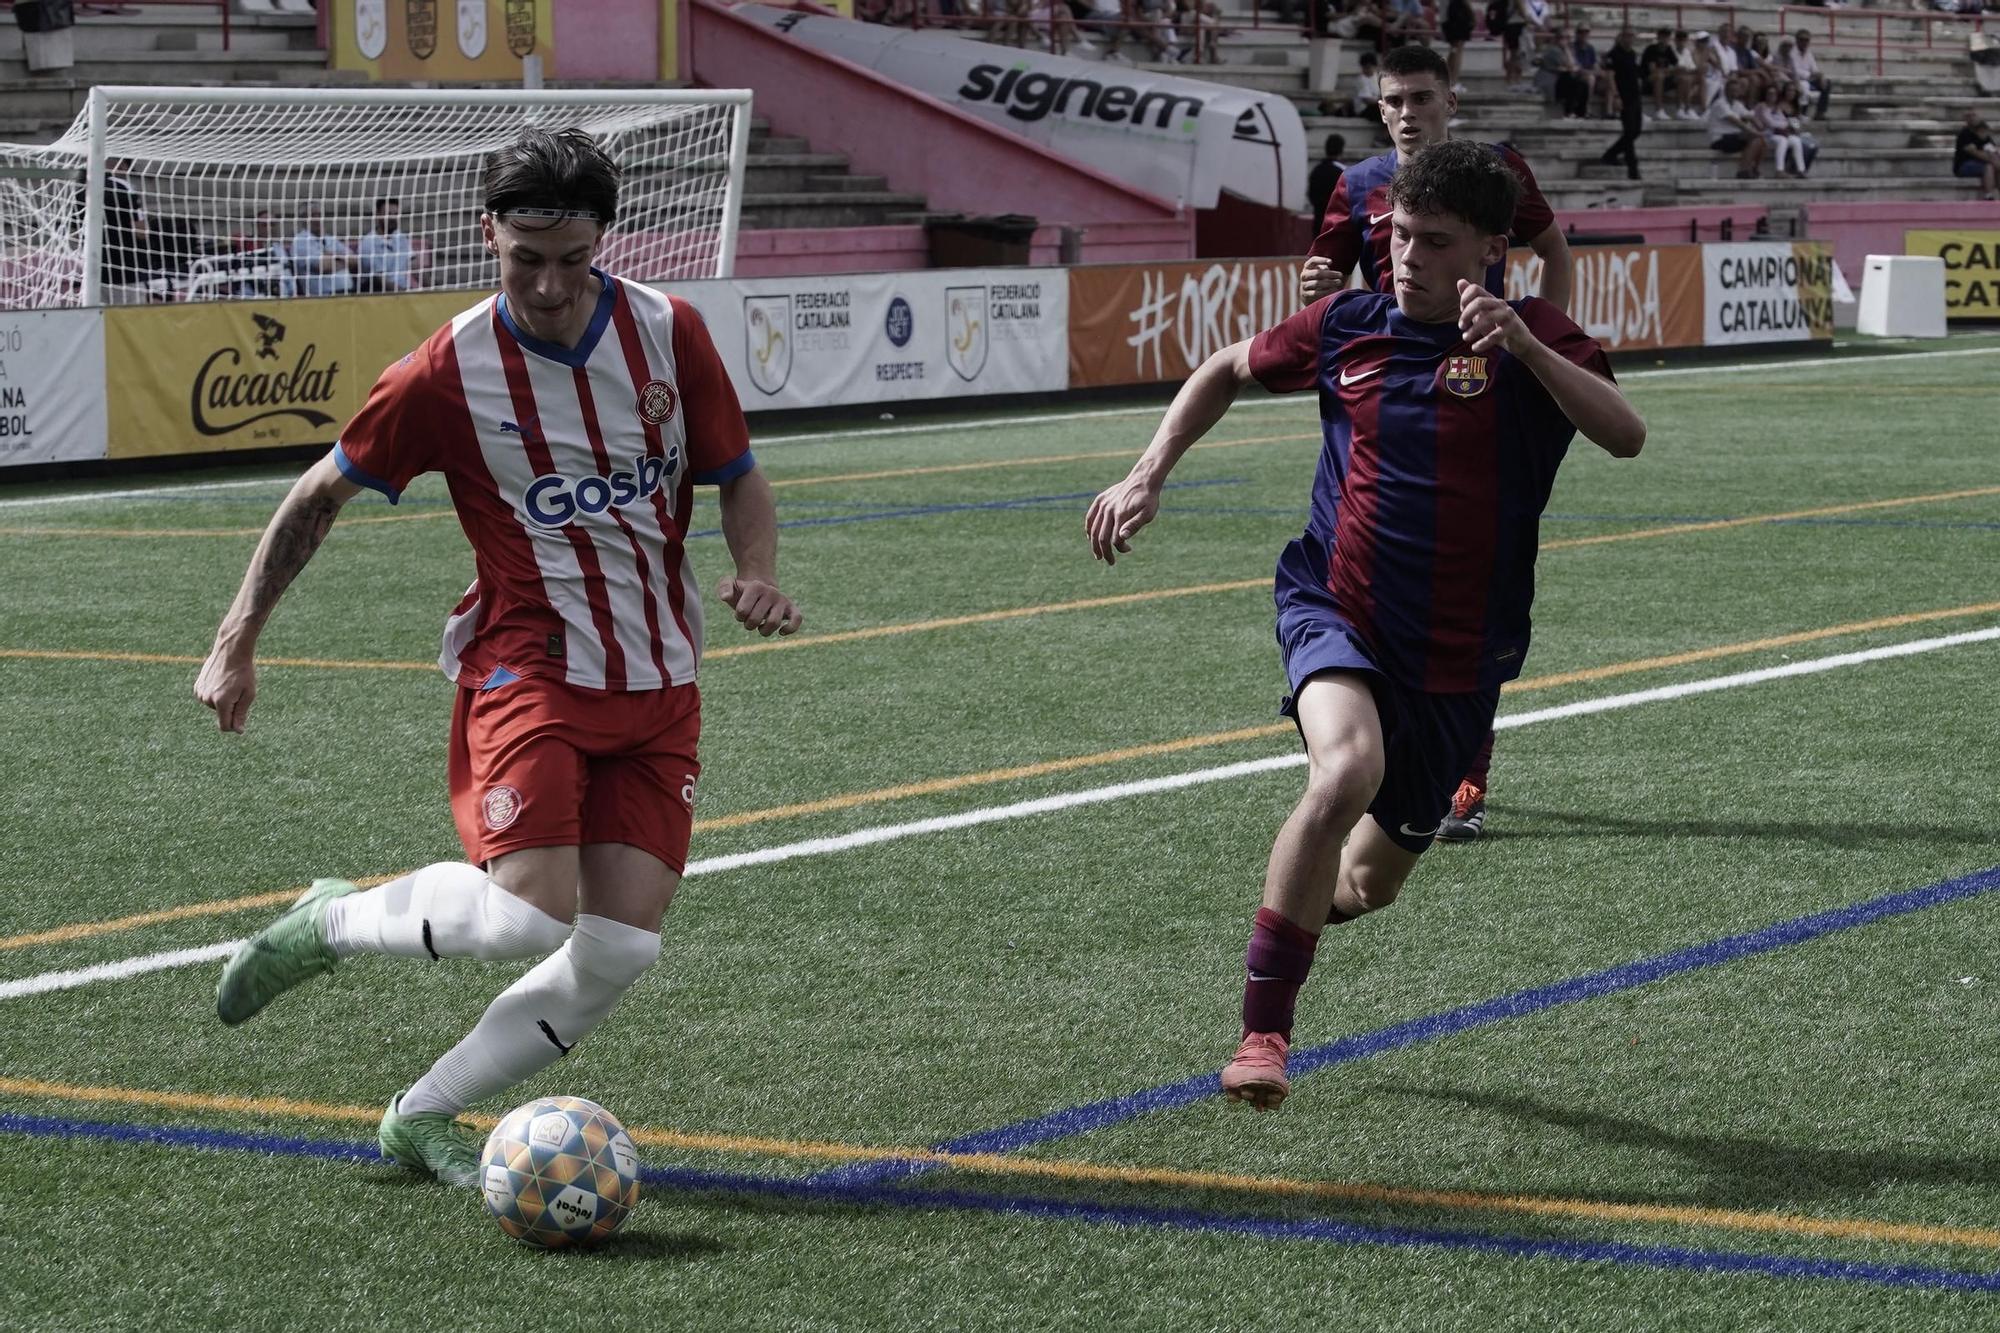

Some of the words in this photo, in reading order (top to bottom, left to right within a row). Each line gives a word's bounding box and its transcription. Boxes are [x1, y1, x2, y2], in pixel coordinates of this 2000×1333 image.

[958, 60, 1204, 134] signem
[1720, 256, 1833, 289] CAMPIONAT
[795, 291, 850, 310] FEDERACIÓ
[990, 282, 1041, 300] FEDERACIÓ
[795, 311, 851, 330] CATALANA
[991, 303, 1042, 320] CATALANA
[1720, 298, 1834, 333] CATALUNYA
[876, 362, 925, 382] RESPECTE
[191, 343, 340, 437] Cacaolat
[524, 444, 679, 526] Gosbi
[556, 1199, 593, 1220] futcat
